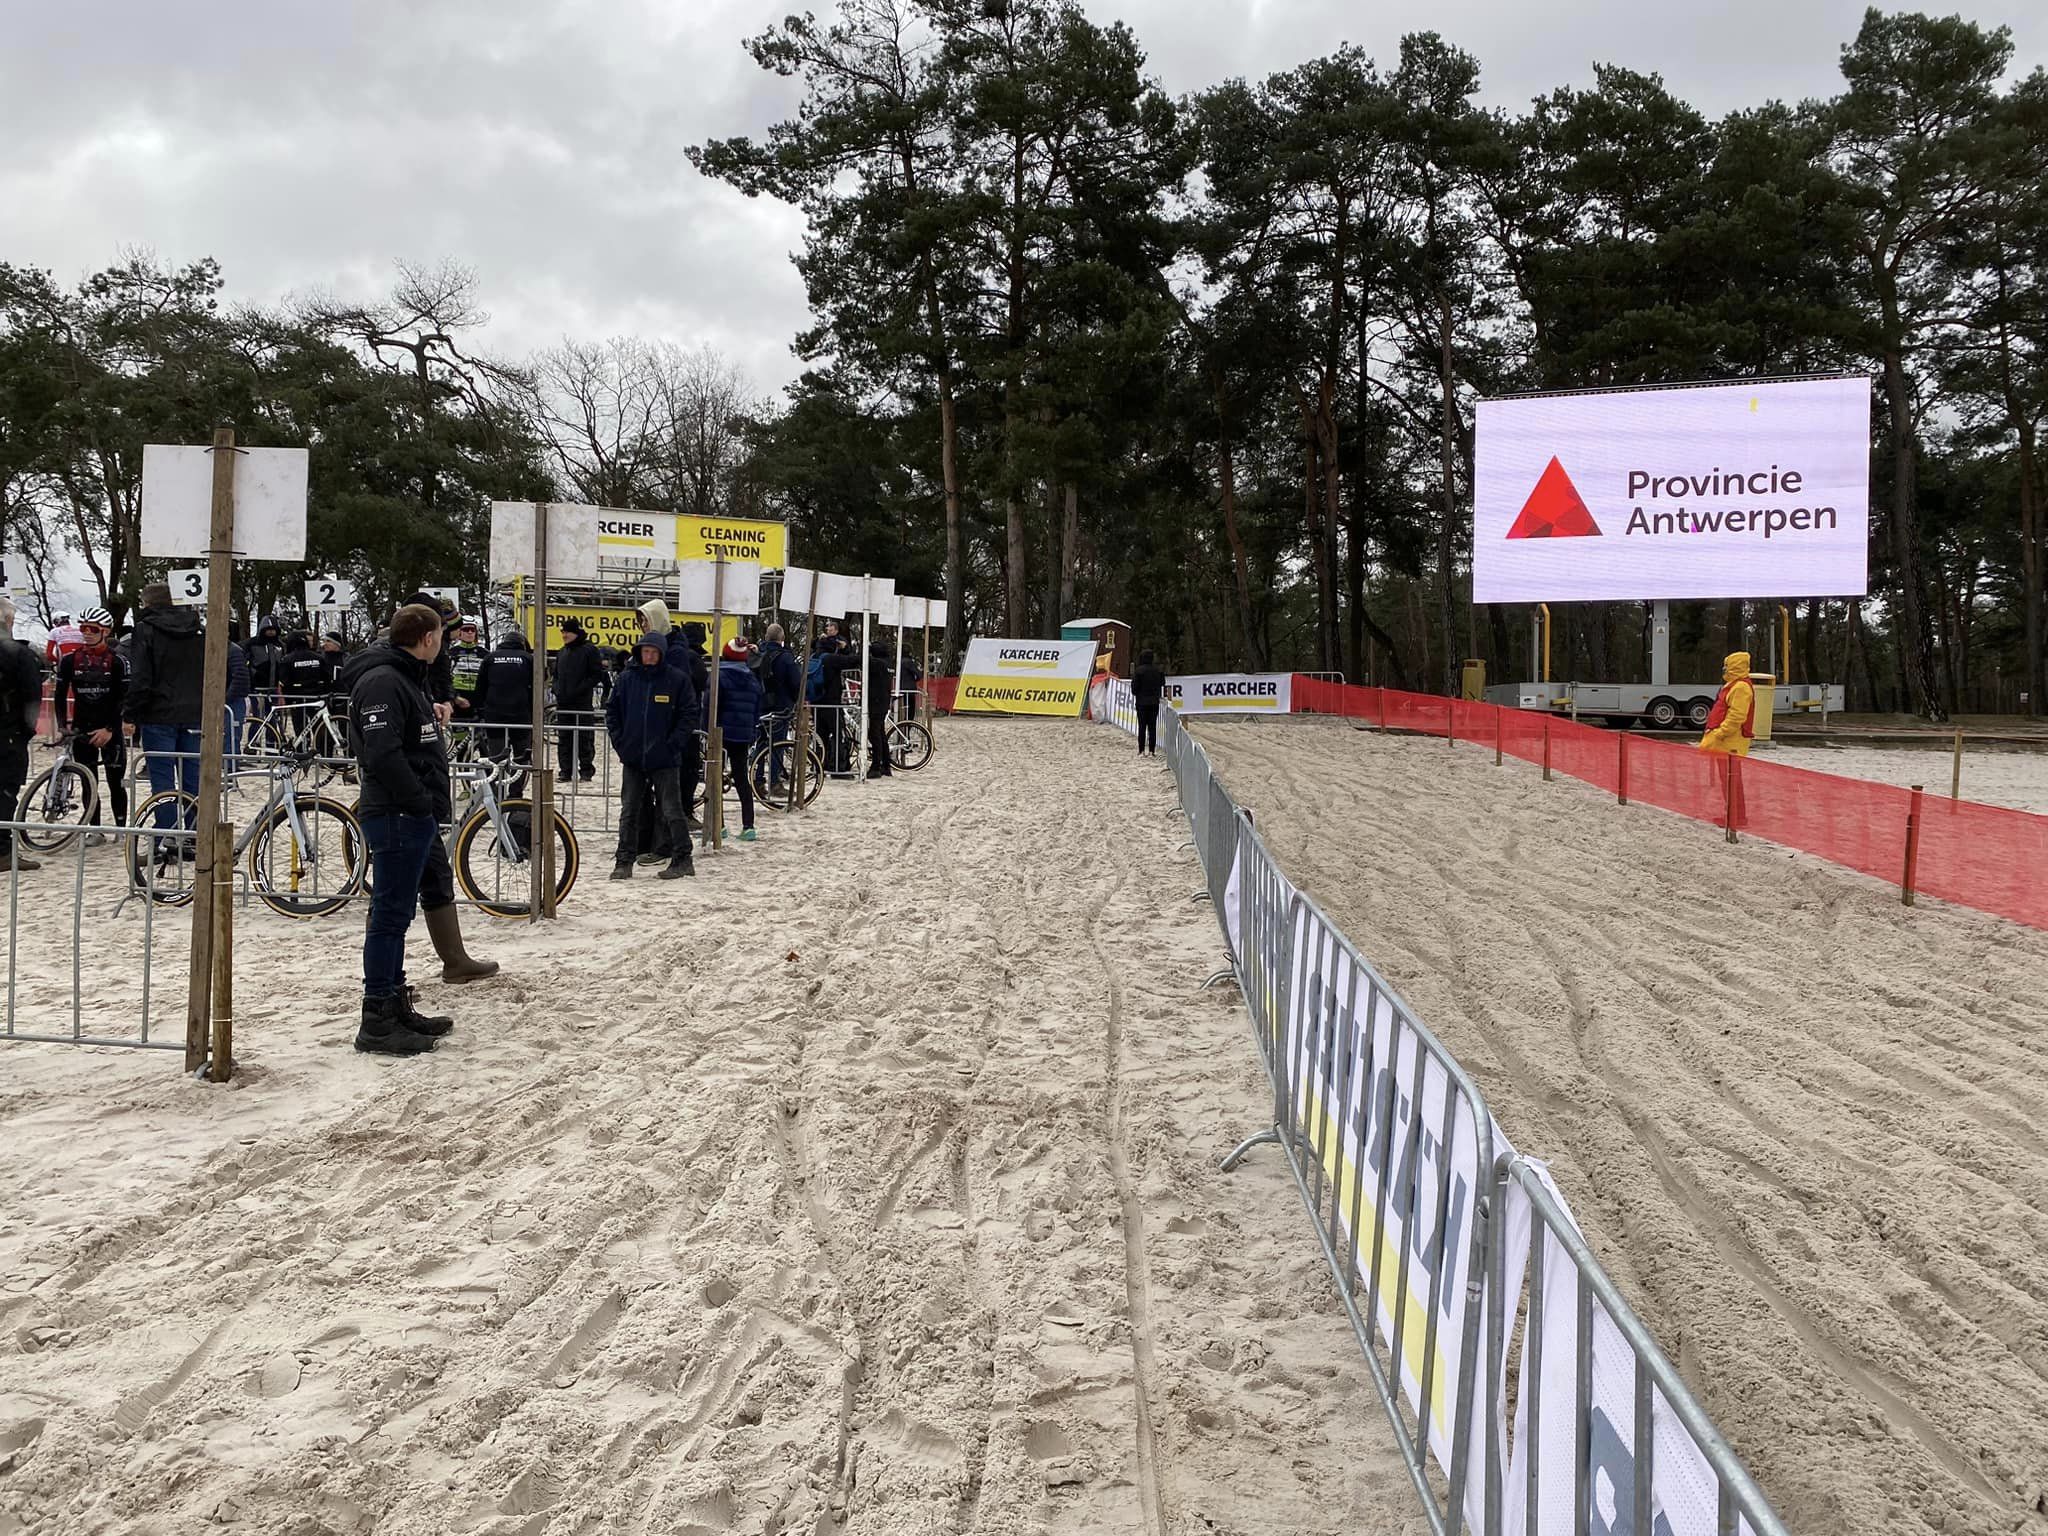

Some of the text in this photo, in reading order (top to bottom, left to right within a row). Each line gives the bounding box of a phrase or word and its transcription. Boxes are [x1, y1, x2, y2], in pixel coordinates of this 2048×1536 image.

[1628, 464, 1802, 499] Provincie
[598, 520, 654, 536] RCHER
[1625, 505, 1837, 539] Antwerpen
[700, 526, 765, 543] CLEANING
[704, 542, 760, 559] STATION
[185, 573, 203, 597] 3
[320, 583, 336, 605] 2
[546, 614, 595, 629] BRNG
[605, 632, 643, 647] YOU
[1000, 648, 1060, 661] KÄRCHER
[965, 685, 1076, 703] CLEANING STATION
[1203, 681, 1277, 696] KÄRCHER
